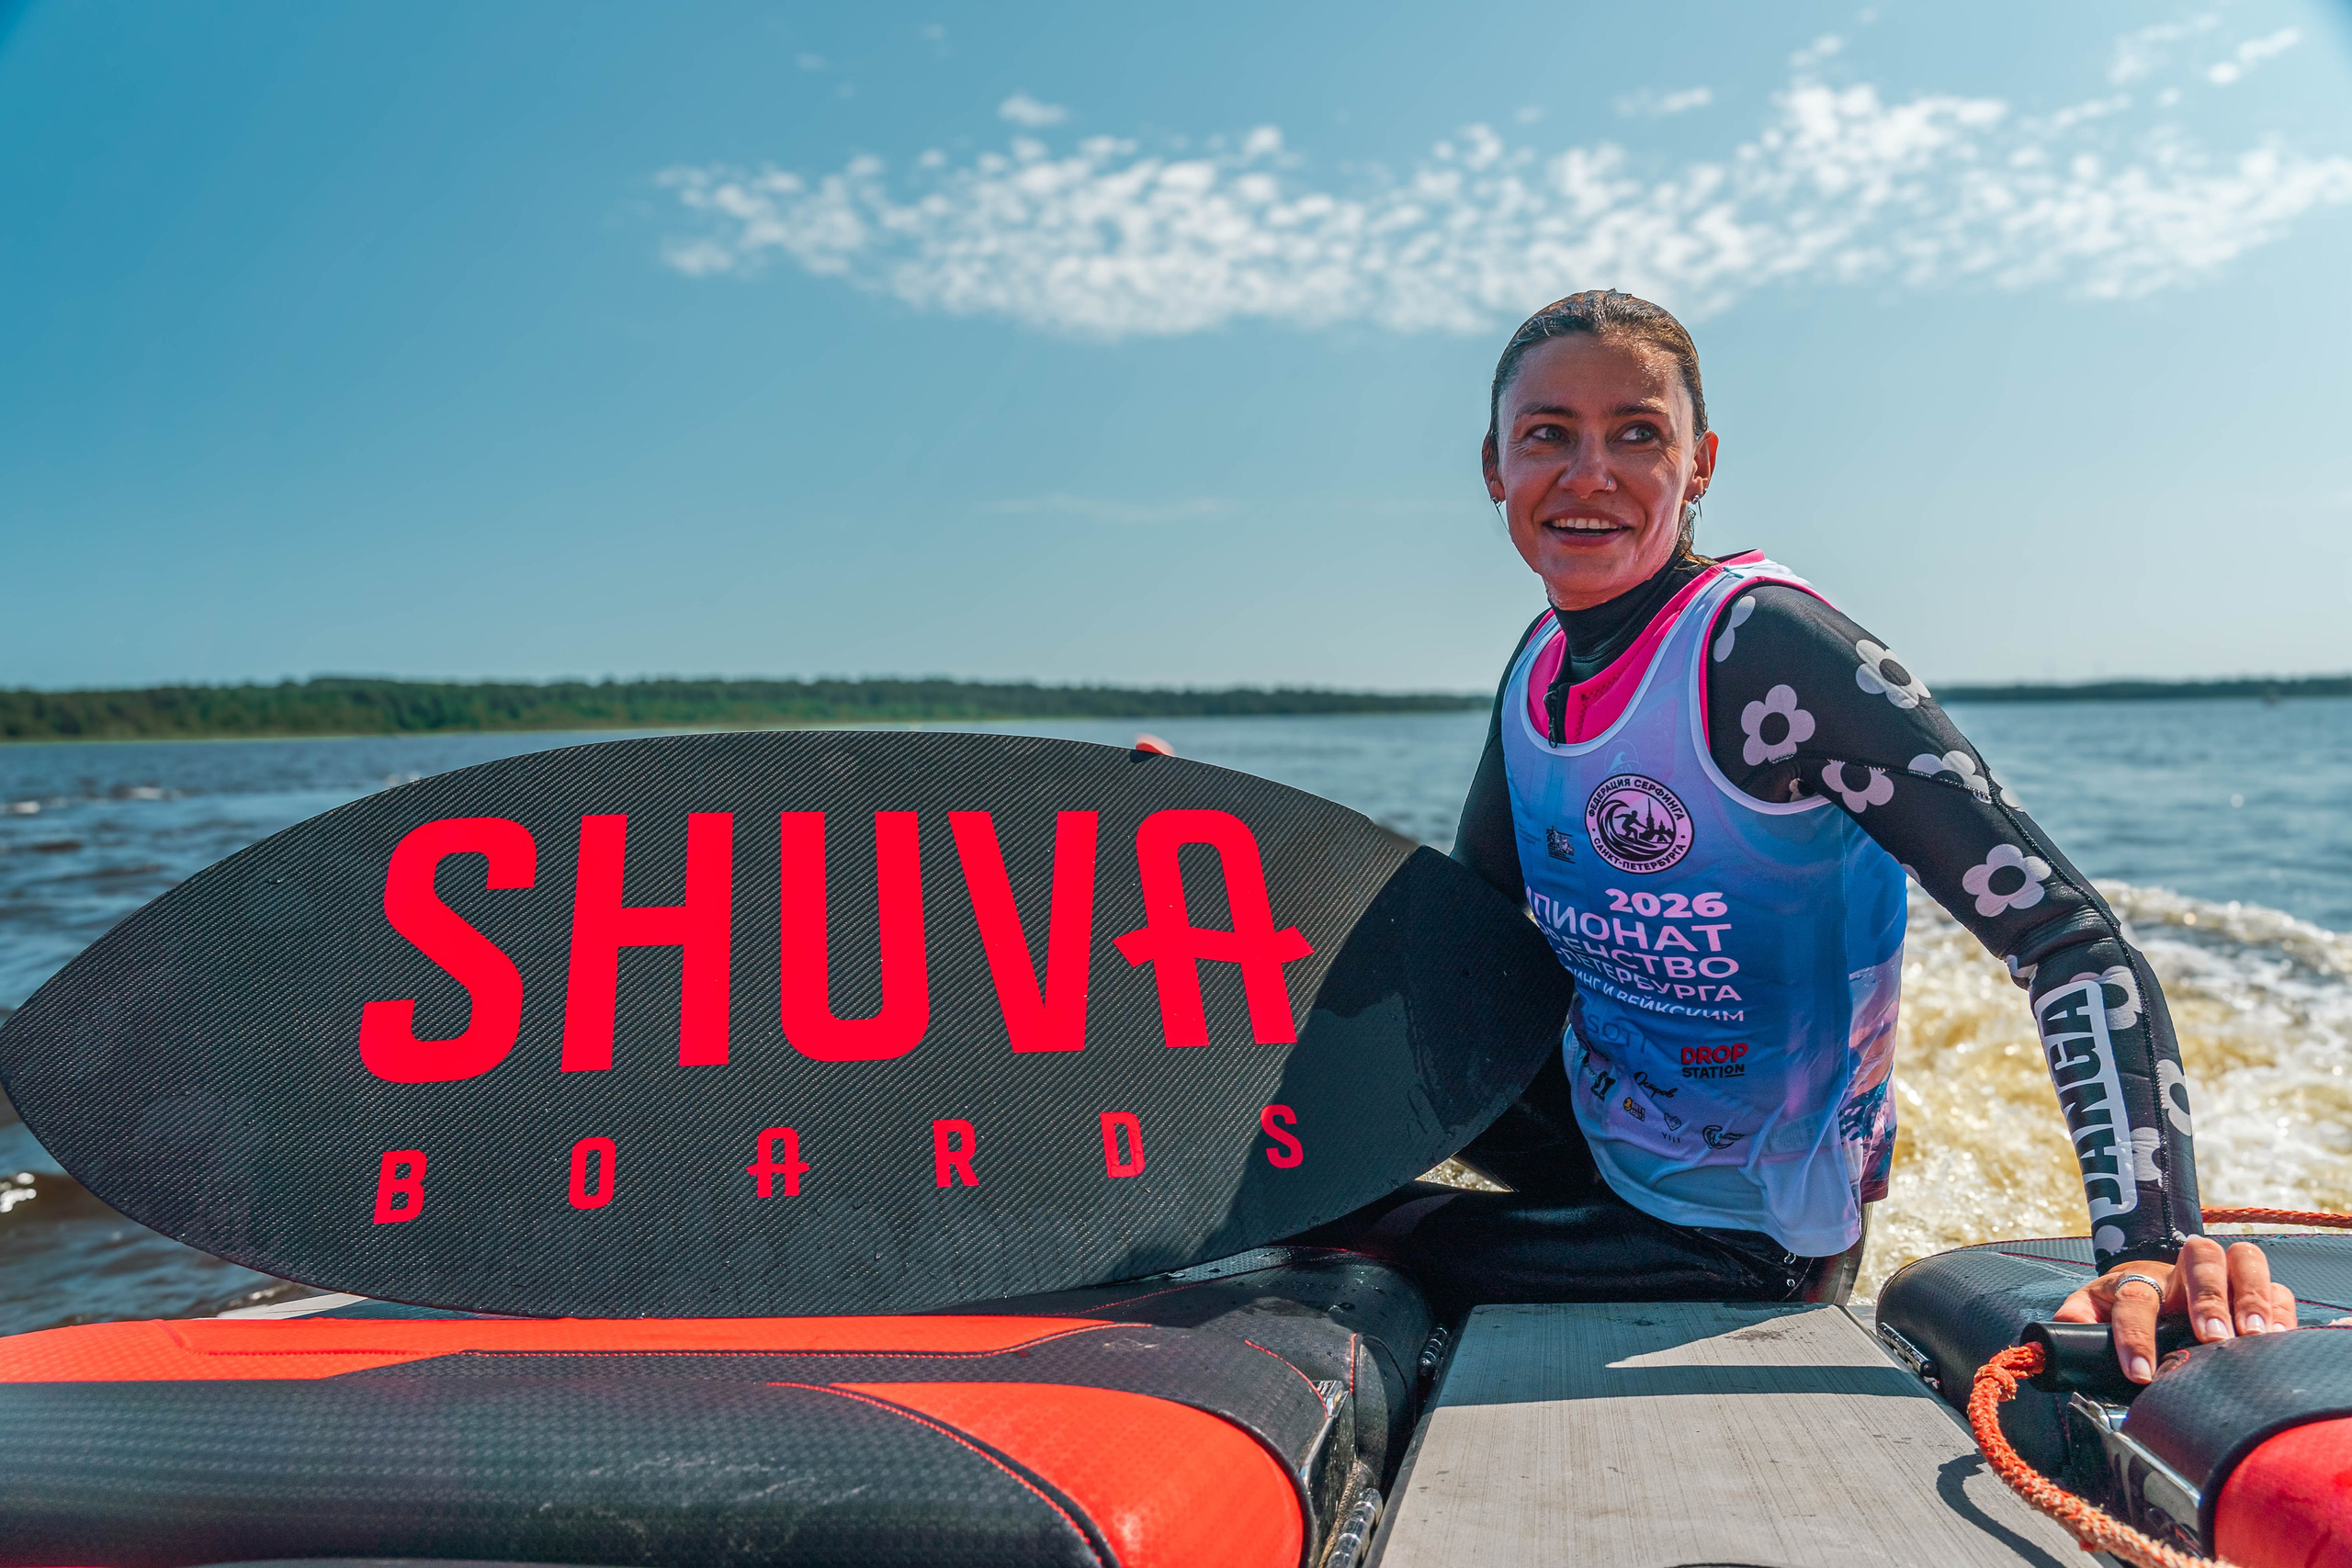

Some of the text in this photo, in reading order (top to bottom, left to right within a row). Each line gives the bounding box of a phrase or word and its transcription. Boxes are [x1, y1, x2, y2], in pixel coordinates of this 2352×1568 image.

[1588, 778, 1685, 821] ФЕДЕРАЦИЯ СЕРФИНГА
[1593, 837, 1687, 872] САНКТ-ПЕТЕРБУРГА
[1604, 887, 1728, 918] 2026
[359, 809, 1314, 1084] SHUVA
[1602, 982, 1612, 997] И
[1681, 1043, 1748, 1065] DROP
[1681, 1064, 1746, 1079] STATION
[2040, 987, 2122, 1206] JANGA
